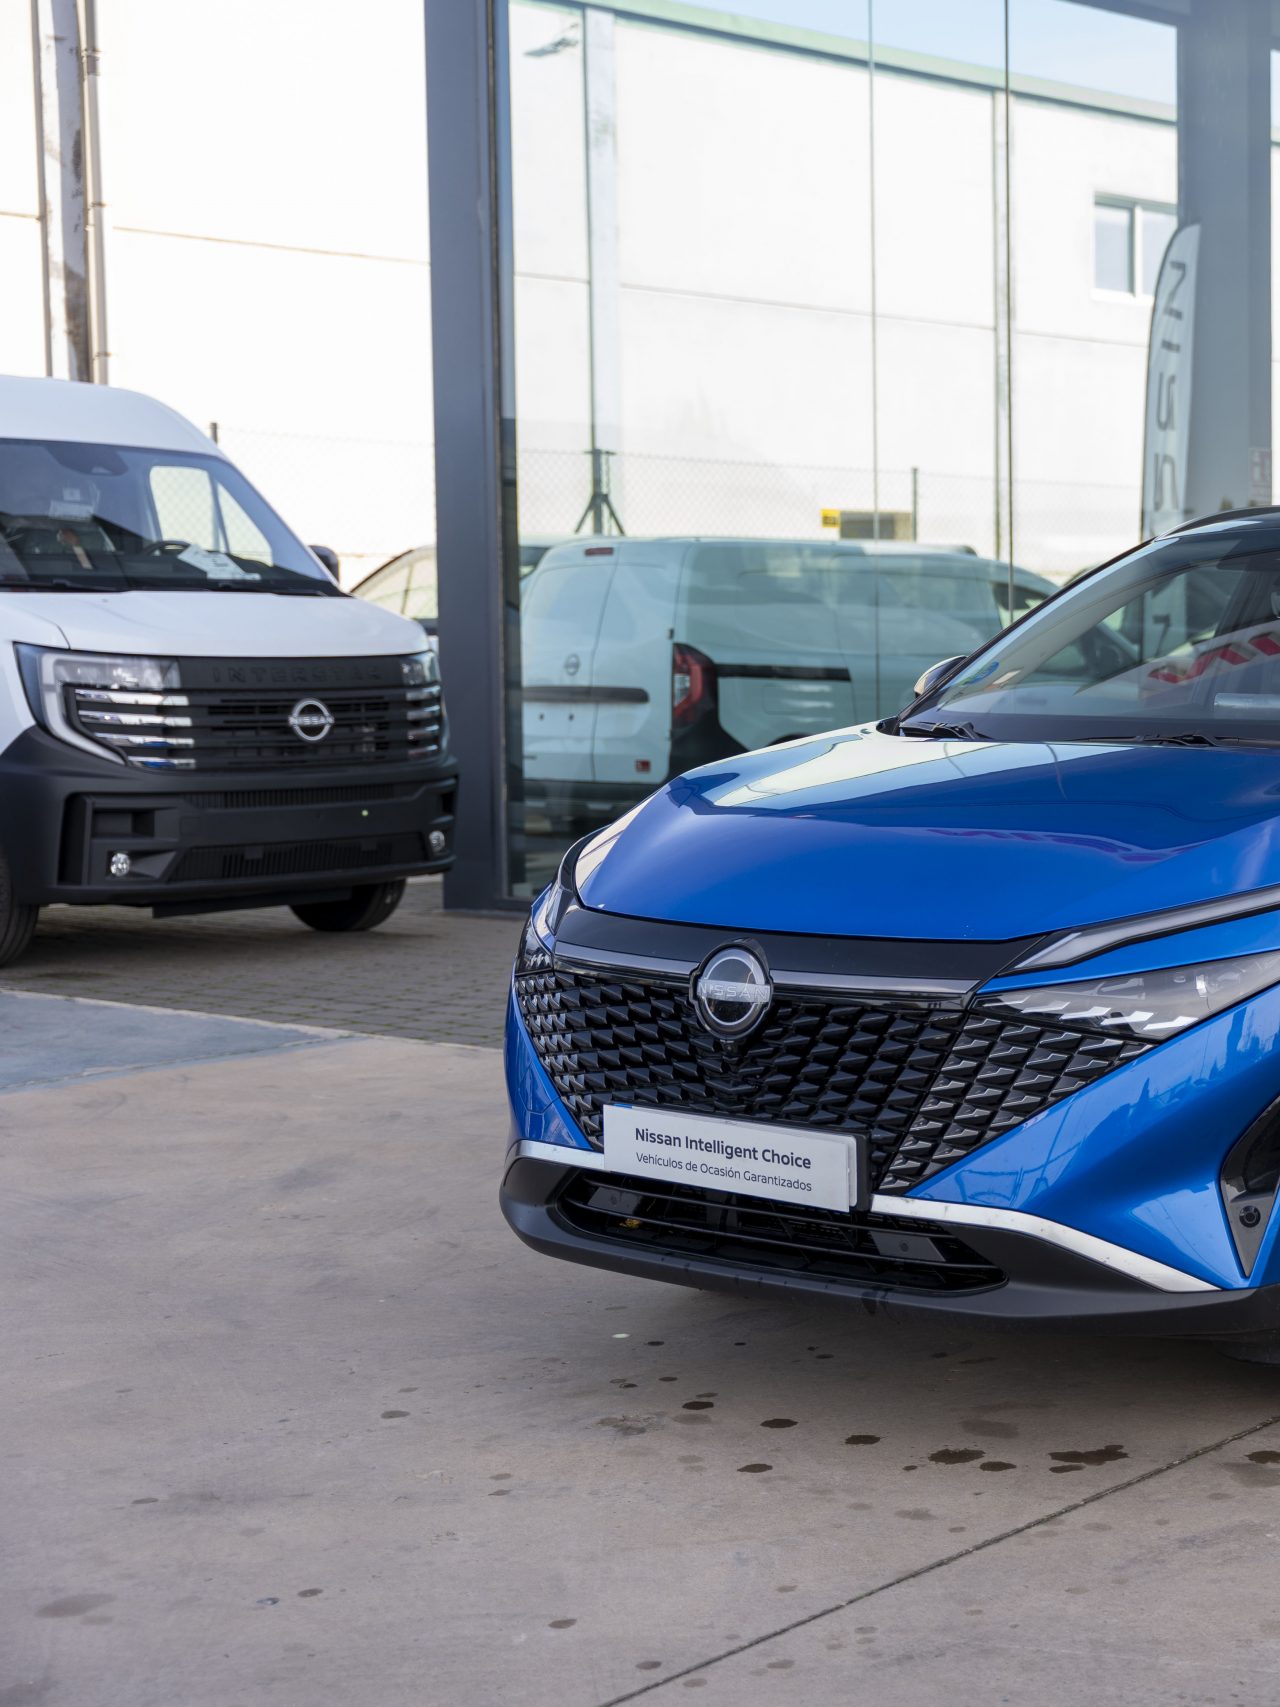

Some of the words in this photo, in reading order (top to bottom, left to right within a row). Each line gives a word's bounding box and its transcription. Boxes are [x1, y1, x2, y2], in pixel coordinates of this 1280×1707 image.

[697, 980, 770, 1002] NISSAN
[635, 1127, 682, 1149] Nissan
[685, 1135, 759, 1161] Intelligent
[761, 1149, 812, 1170] Choice
[635, 1152, 683, 1170] Vehículos
[685, 1160, 698, 1173] de
[700, 1163, 741, 1180] Ocasión
[743, 1170, 813, 1192] Garantizados
